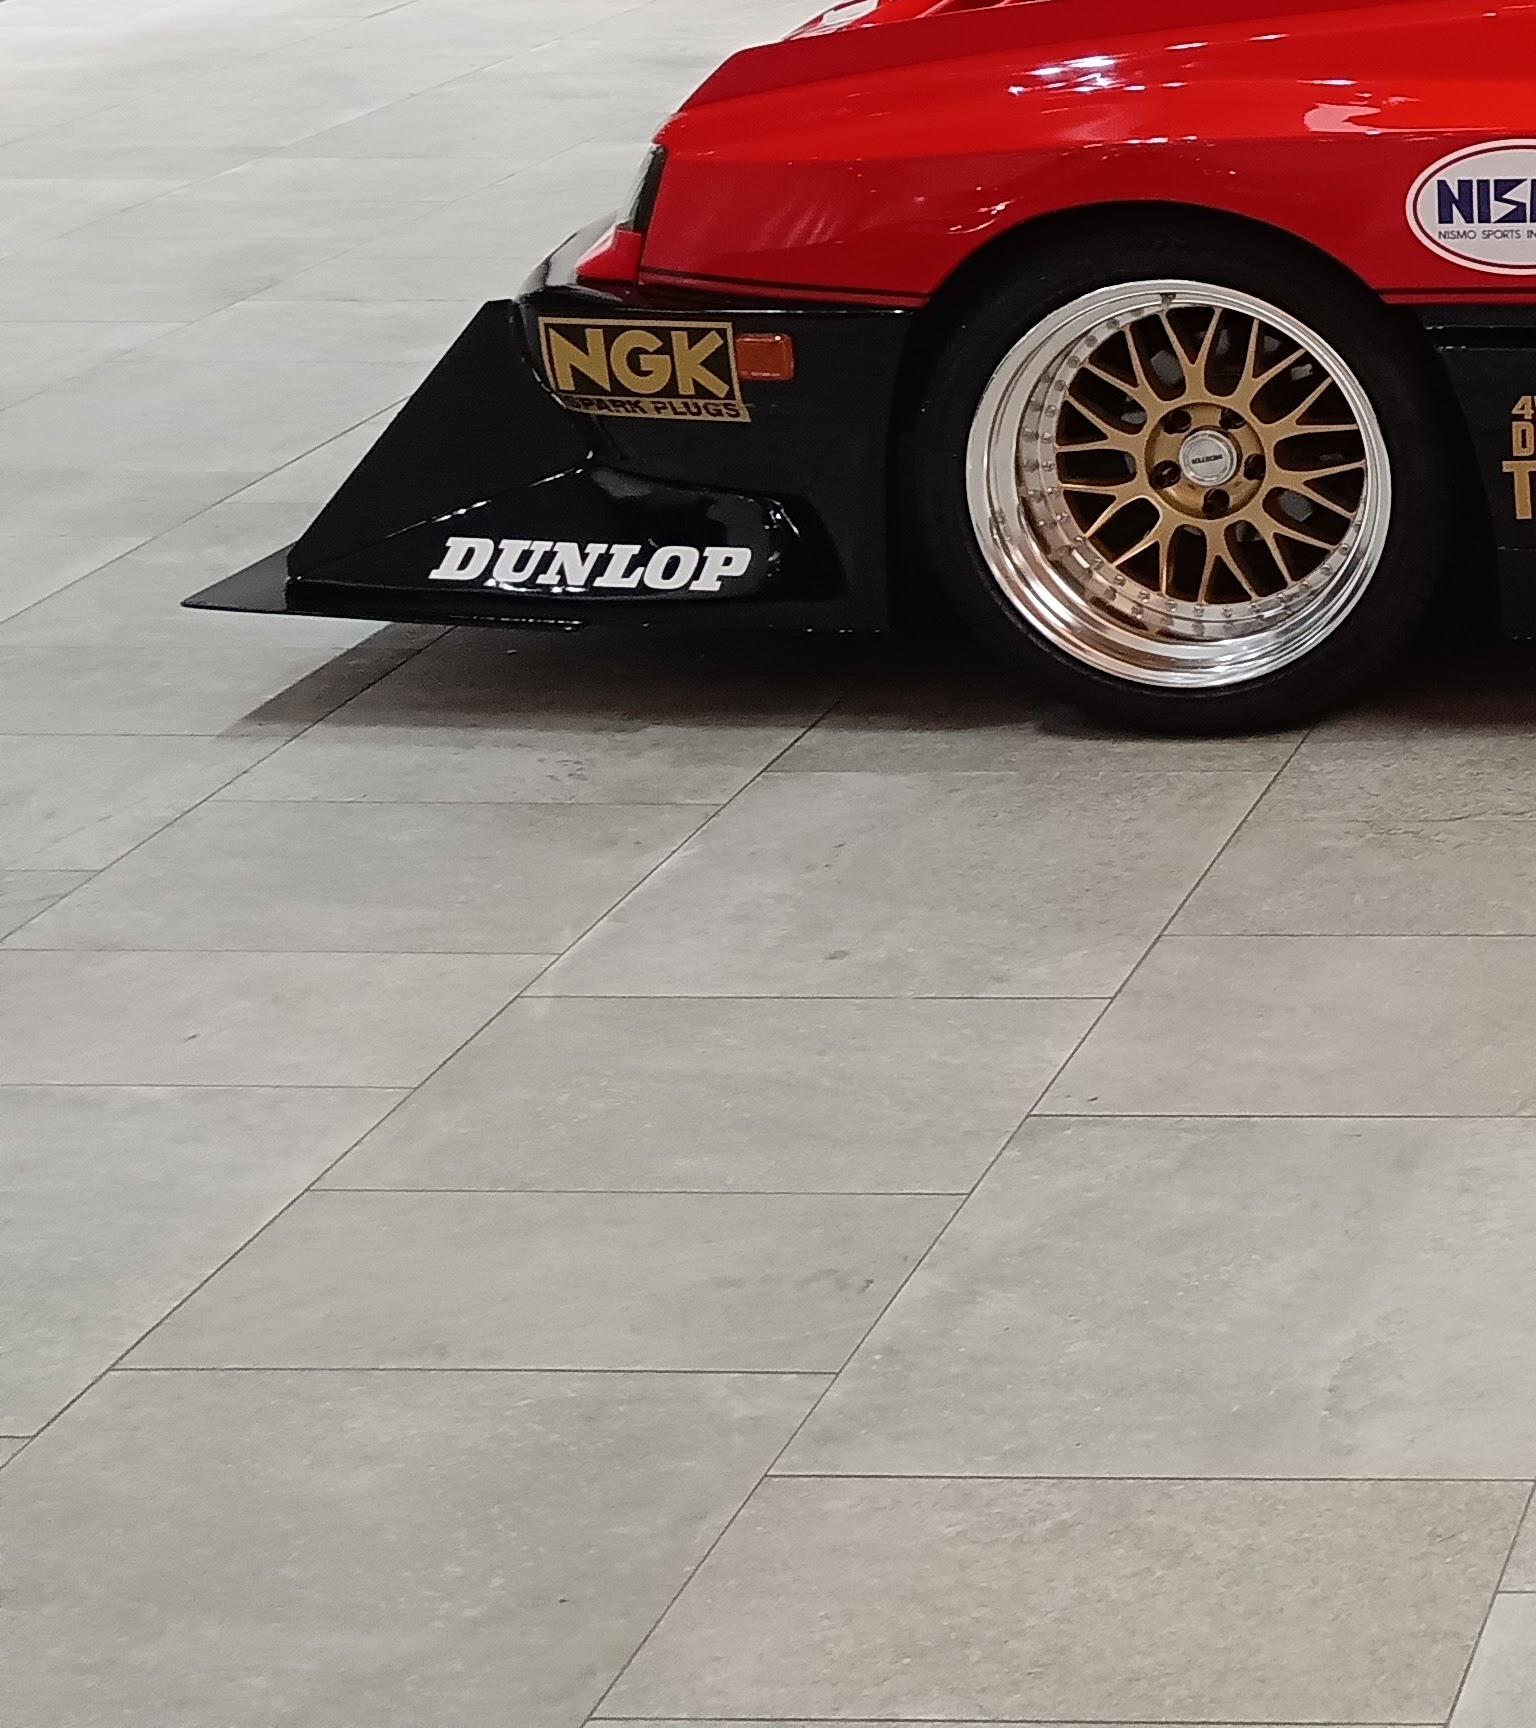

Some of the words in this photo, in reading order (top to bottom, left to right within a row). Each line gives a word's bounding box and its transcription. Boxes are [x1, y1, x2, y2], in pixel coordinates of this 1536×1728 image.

[1438, 229, 1477, 240] NISMO
[1481, 229, 1521, 239] SPORTS
[549, 328, 730, 398] NGK
[566, 395, 648, 414] SPARK
[653, 398, 741, 418] PLUGS
[428, 537, 752, 592] DUNLOP
